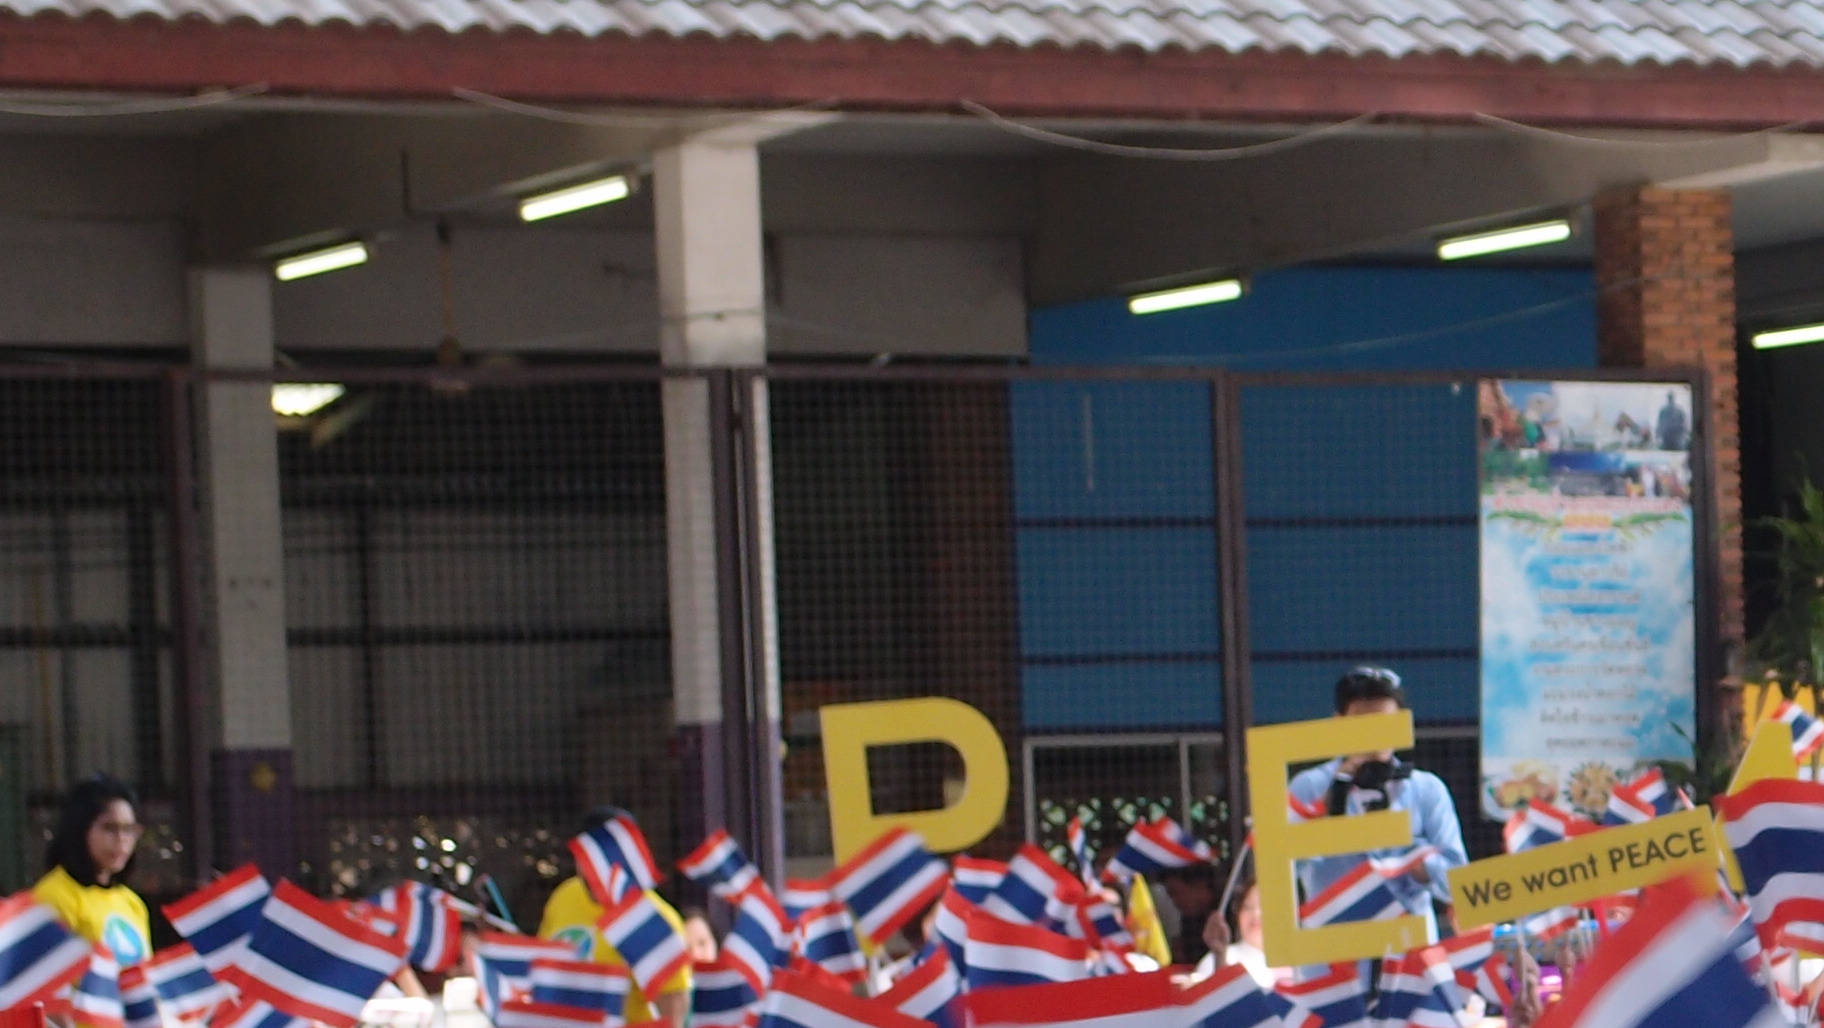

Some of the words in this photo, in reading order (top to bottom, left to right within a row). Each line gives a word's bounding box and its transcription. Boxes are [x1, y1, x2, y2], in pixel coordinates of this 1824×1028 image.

[1462, 878, 1511, 908] We
[1522, 854, 1599, 893] want
[1609, 827, 1707, 873] PEACE
